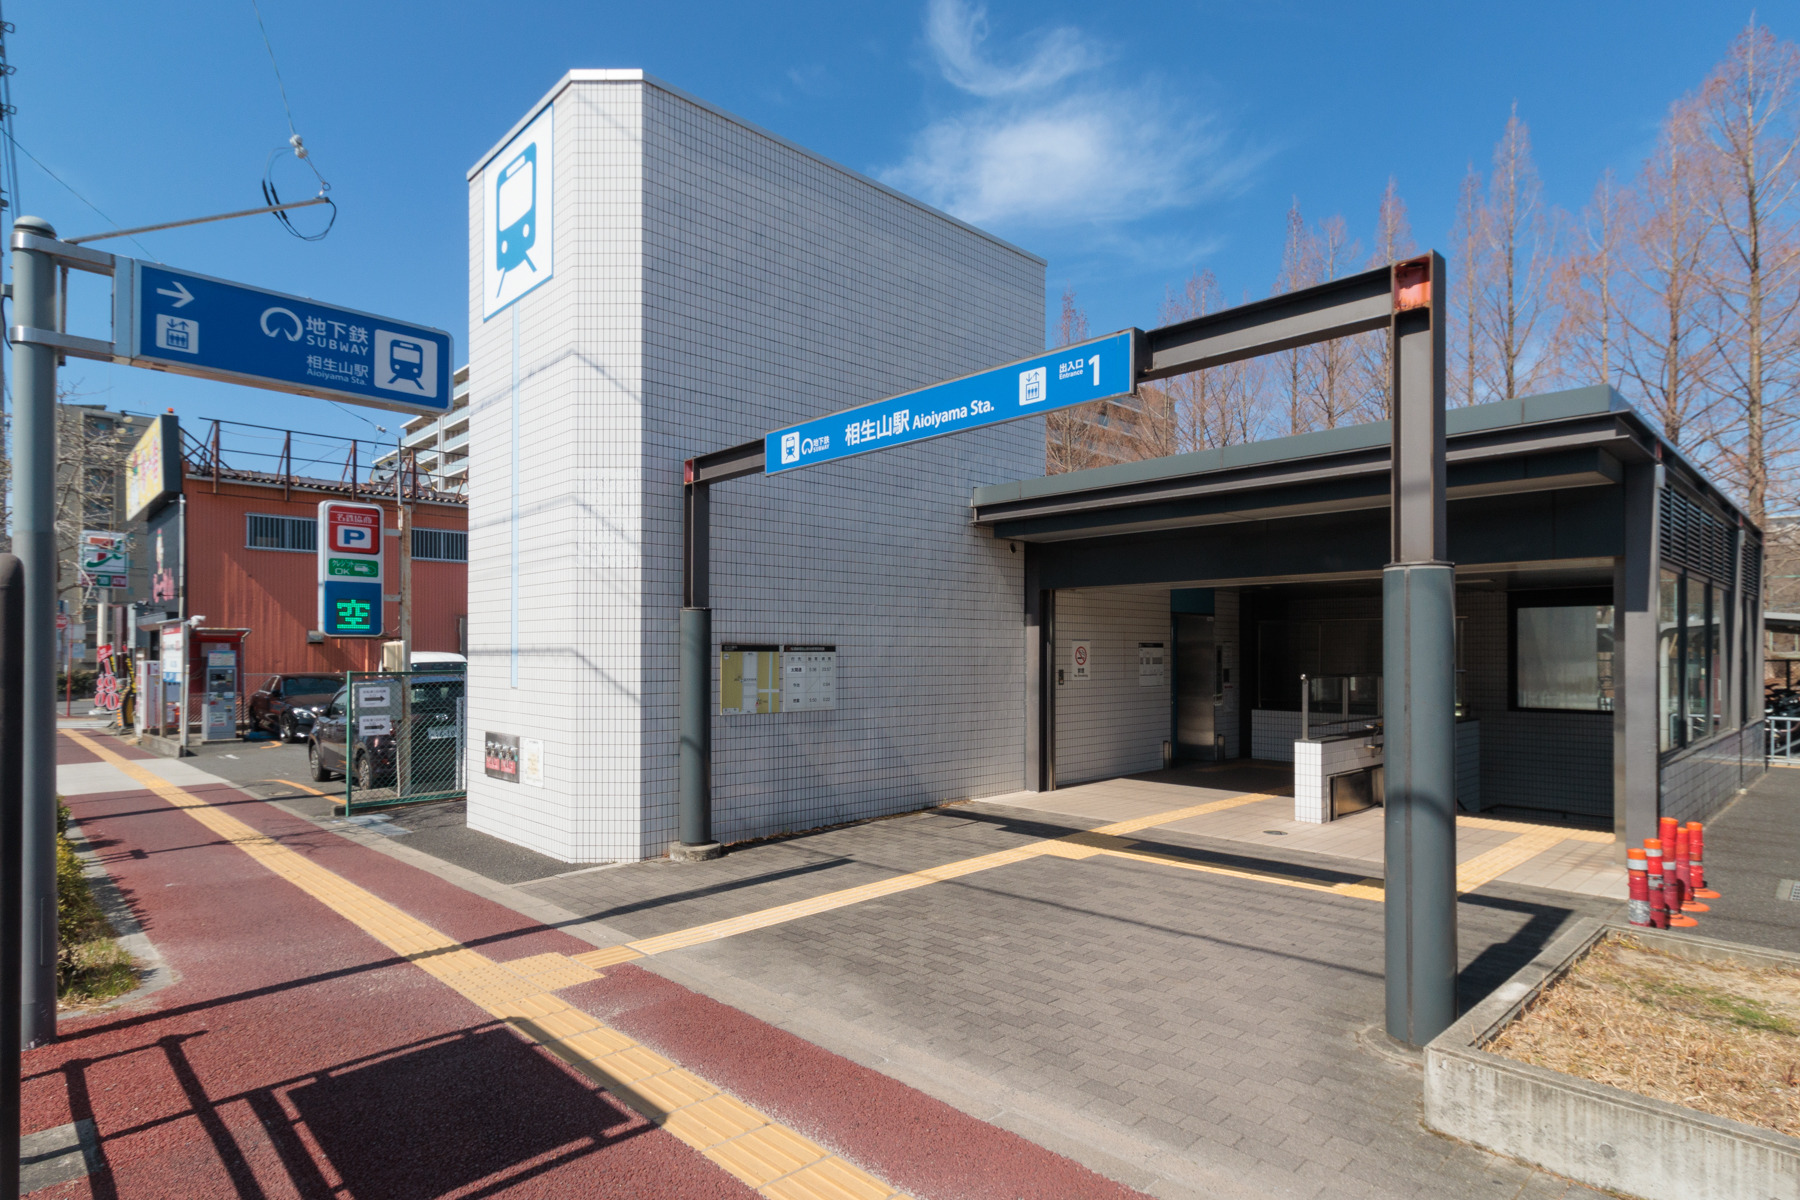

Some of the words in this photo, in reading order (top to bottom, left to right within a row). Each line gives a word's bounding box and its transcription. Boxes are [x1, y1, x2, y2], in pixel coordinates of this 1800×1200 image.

[306, 315, 368, 345] 地下鉄
[306, 335, 369, 356] SUBWAY
[306, 354, 369, 378] 相生山駅
[1059, 358, 1084, 374] 出入口
[1059, 369, 1084, 380] Entrance
[1088, 354, 1100, 386] 1
[307, 368, 349, 382] Aioiyama
[350, 376, 367, 386] Sta.
[912, 410, 968, 430] Aioiyama
[970, 399, 995, 416] Sta.
[845, 409, 910, 447] 相生山駅
[813, 435, 830, 447] 地下鉄
[336, 513, 373, 524] 名鉄協商
[343, 528, 366, 545] P
[335, 567, 350, 575] OK
[336, 599, 371, 630] 空
